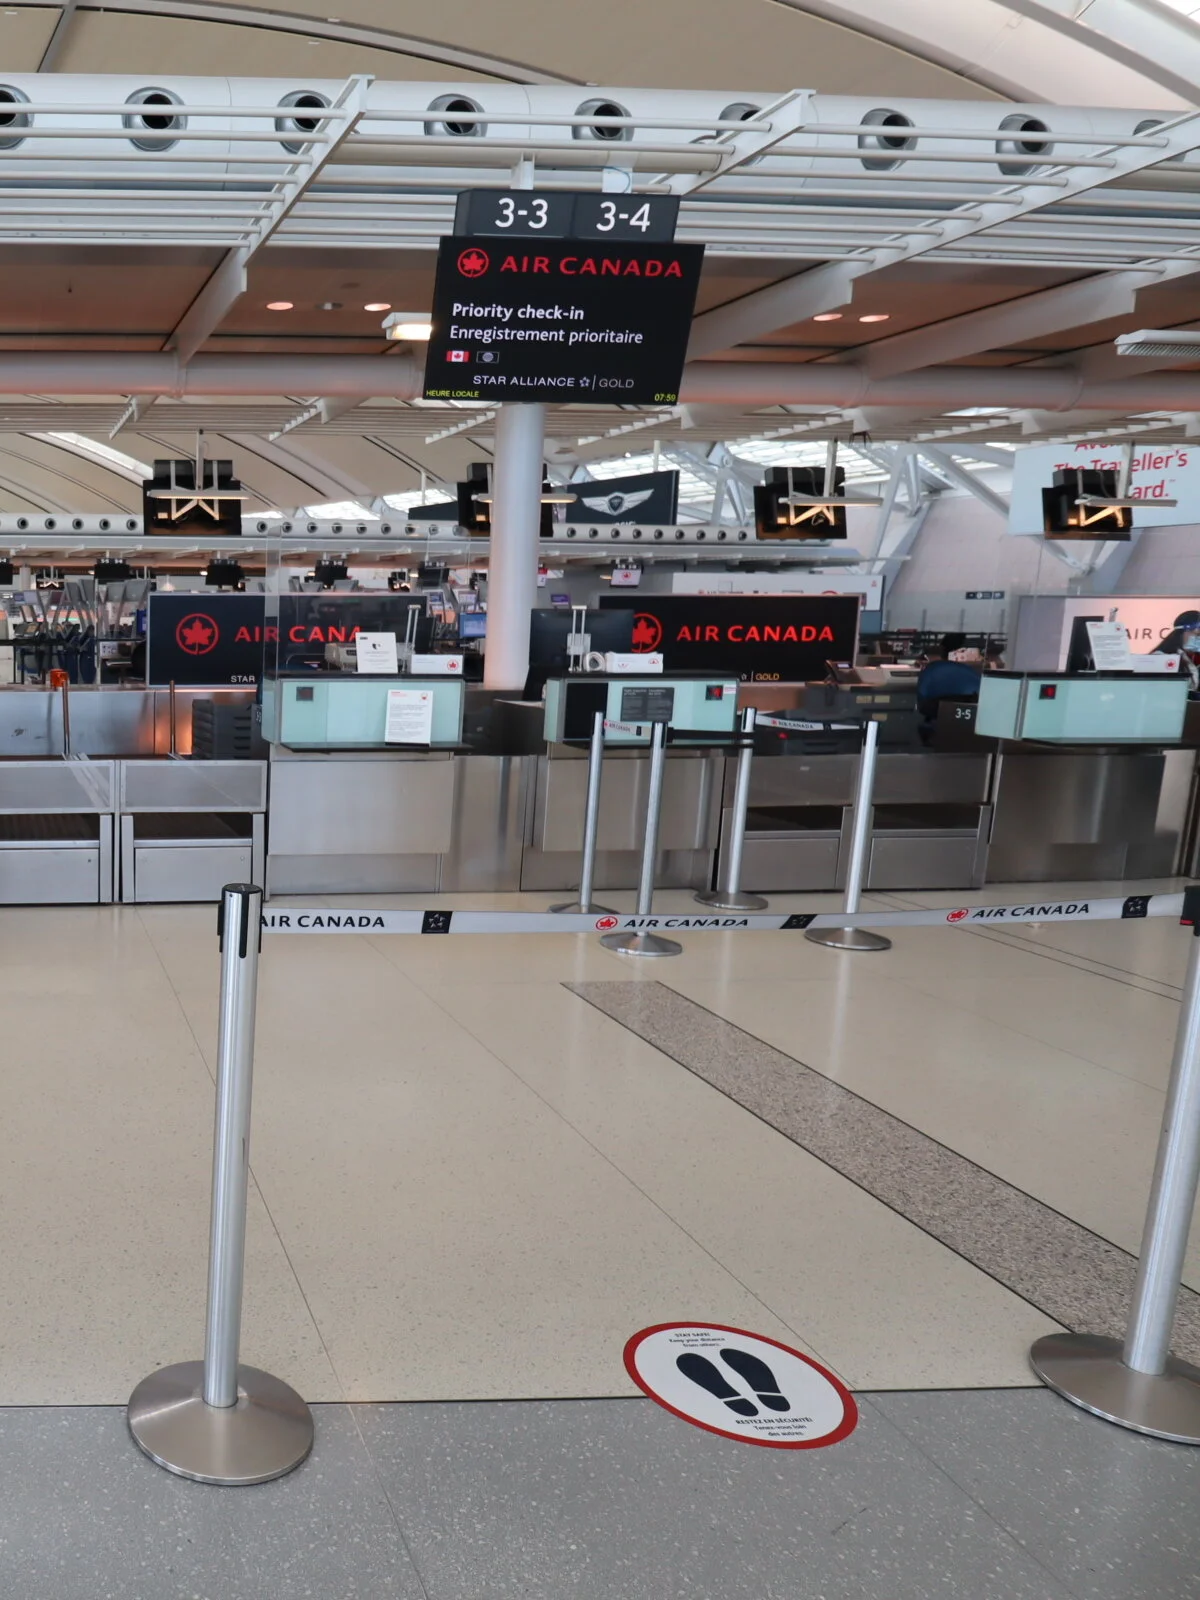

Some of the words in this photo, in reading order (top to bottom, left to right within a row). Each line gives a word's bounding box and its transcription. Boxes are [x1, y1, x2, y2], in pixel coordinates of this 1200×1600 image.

[494, 198, 549, 229] 3-3
[596, 201, 651, 233] 3-4
[500, 255, 550, 274] AIR
[559, 257, 683, 278] CANADA
[452, 303, 513, 321] Priority
[517, 304, 585, 321] check-in
[450, 325, 565, 344] Enregistrement
[568, 329, 644, 346] prioritaire
[473, 375, 507, 386] STAR
[510, 376, 576, 387] ALLIANCE
[598, 378, 635, 389] GOLD
[426, 389, 450, 398] HEURE
[452, 390, 480, 398] LOCALE
[1090, 449, 1188, 473] Traeller's
[1129, 479, 1169, 500] ard.
[235, 626, 280, 642] AIR
[289, 625, 362, 642] CANA
[677, 625, 719, 642] AIR
[727, 625, 835, 642] CANADA
[230, 675, 256, 683] STAR
[755, 672, 780, 681] GOLD
[955, 708, 971, 720] 3-5
[972, 908, 1006, 918] AIR
[1010, 903, 1089, 917] CANADA
[261, 915, 291, 928] AIR
[297, 915, 385, 928] CANADA
[624, 918, 659, 928] AIR
[665, 918, 748, 928] CANADA
